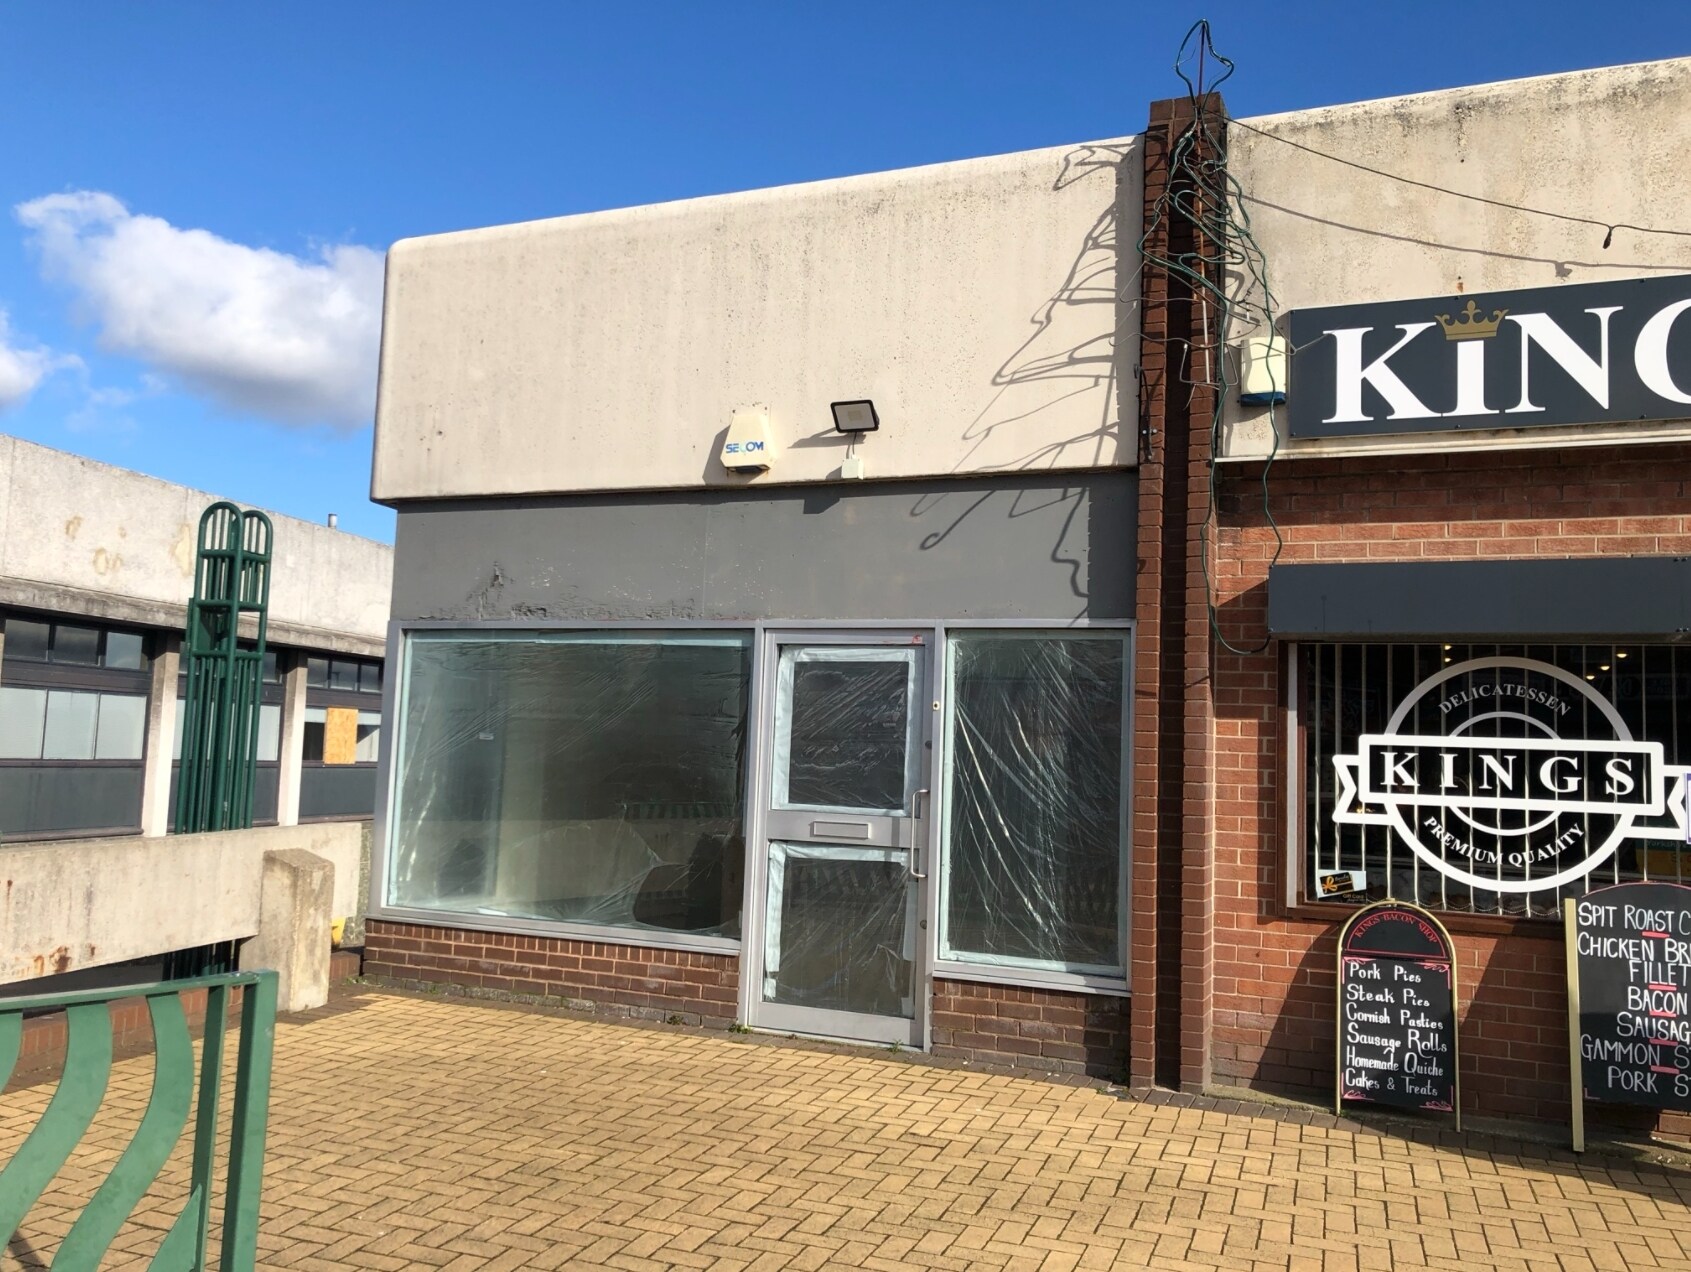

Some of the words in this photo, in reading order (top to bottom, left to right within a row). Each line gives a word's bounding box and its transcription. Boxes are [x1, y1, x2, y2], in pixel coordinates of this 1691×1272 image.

[1438, 683, 1572, 717] DELICATESSEN
[1380, 751, 1635, 796] KINGS
[1423, 816, 1504, 866] PREMIUM
[1508, 822, 1586, 868] QUALITY
[1354, 916, 1381, 939] KINGS
[1382, 913, 1415, 925] BACON
[1418, 922, 1438, 943] SHOP
[1577, 901, 1617, 928] SPIT
[1624, 904, 1675, 933] ROAST
[1577, 931, 1655, 962] CHICKEN
[1664, 937, 1691, 965] BR
[1349, 961, 1381, 980] Pork
[1393, 964, 1422, 983] Pies
[1628, 959, 1691, 987] FILLET
[1346, 983, 1395, 1004] Steak
[1403, 988, 1430, 1007] Pies
[1627, 986, 1688, 1016] BACON
[1346, 1001, 1391, 1024] Cornish
[1400, 1009, 1444, 1030] Pasties
[1346, 1021, 1402, 1054] Sausage
[1407, 1028, 1448, 1059] Rolls
[1580, 1033, 1660, 1067] GAMMON
[1674, 1045, 1691, 1069] S
[1346, 1045, 1400, 1071] Homemade
[1403, 1051, 1444, 1076] Quiche
[1345, 1067, 1380, 1091] Cakes
[1386, 1076, 1396, 1091] &
[1400, 1075, 1438, 1097] Treats
[1607, 1065, 1659, 1095] PORK
[1674, 1073, 1691, 1097] S
